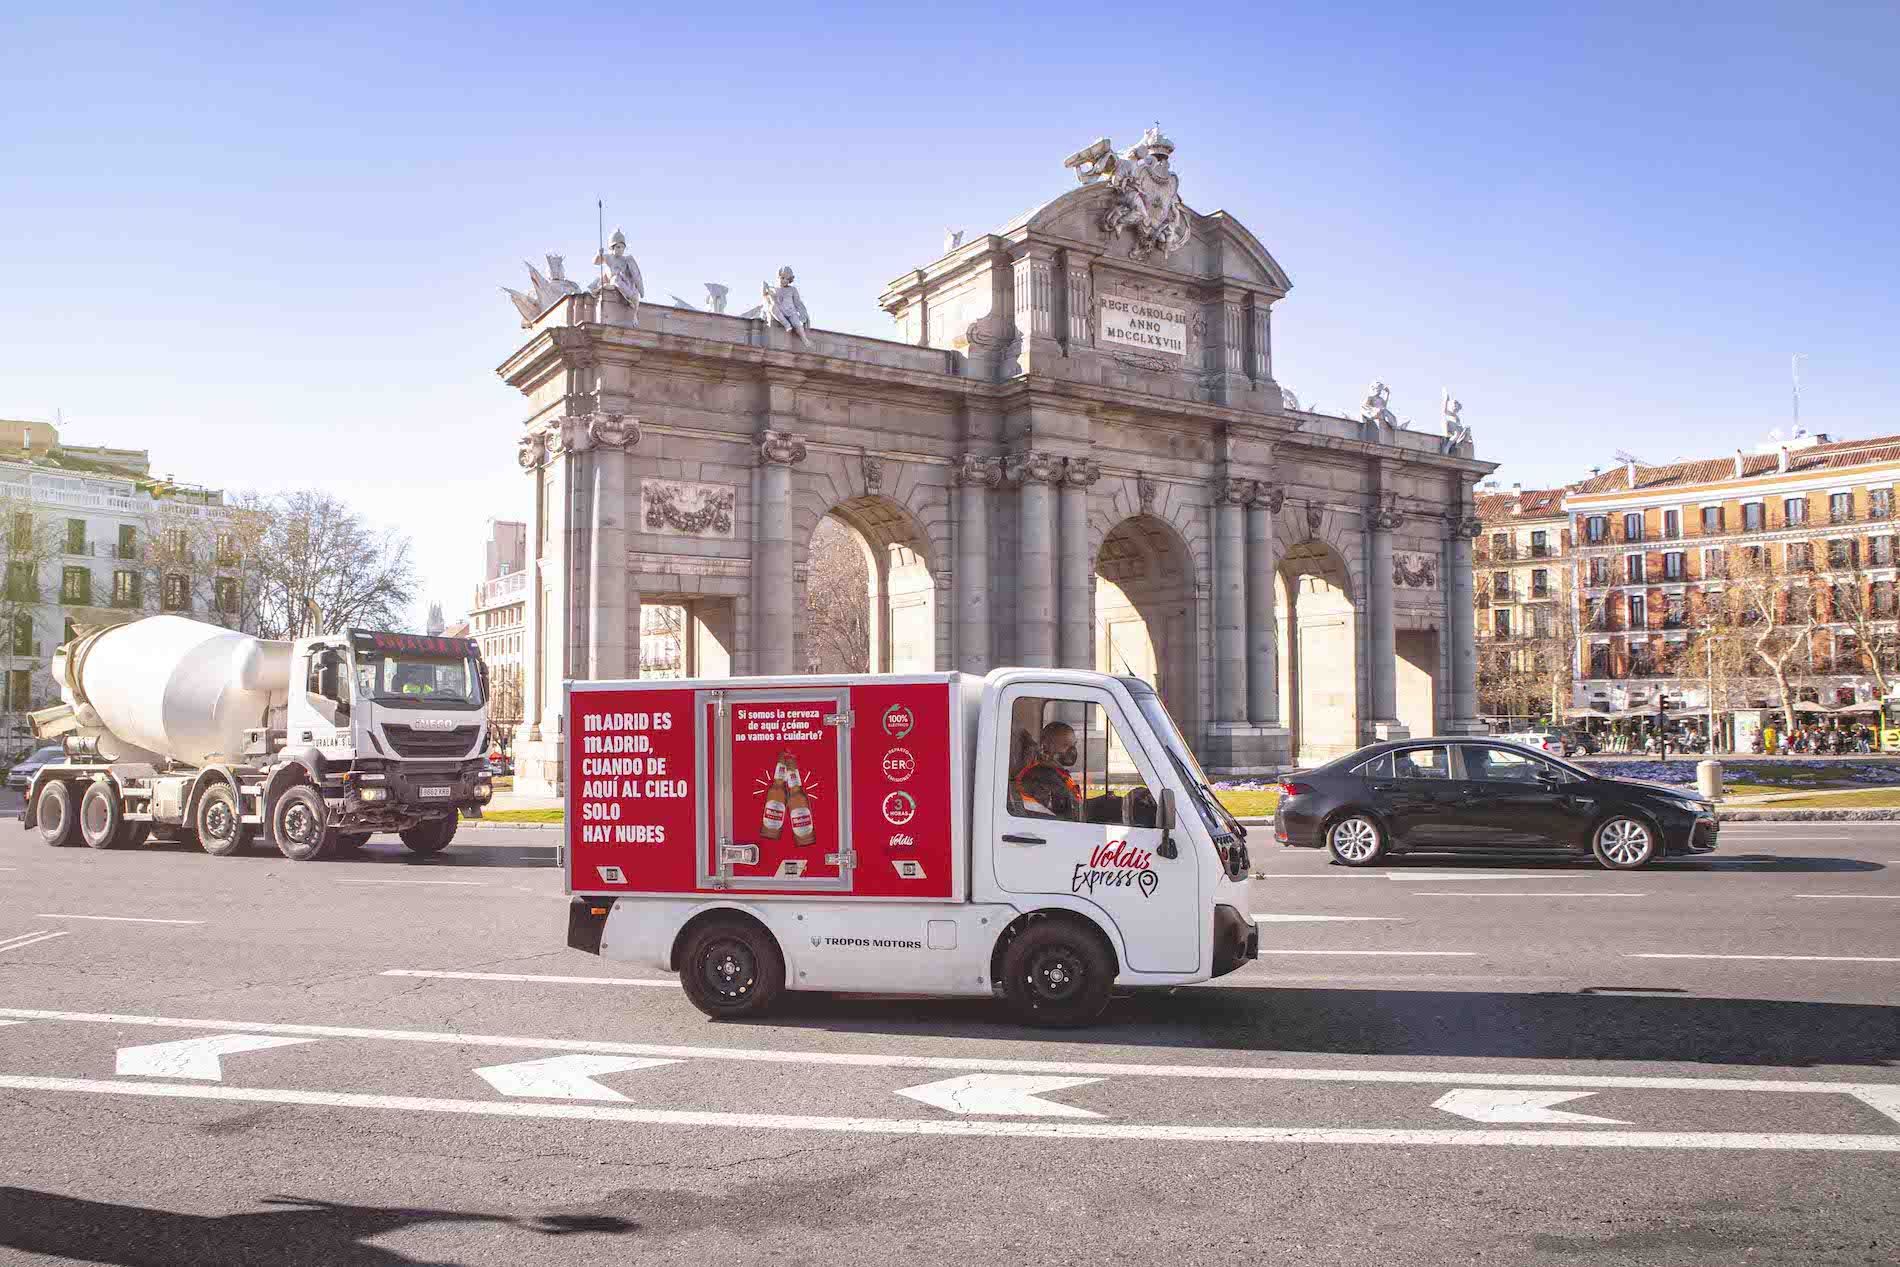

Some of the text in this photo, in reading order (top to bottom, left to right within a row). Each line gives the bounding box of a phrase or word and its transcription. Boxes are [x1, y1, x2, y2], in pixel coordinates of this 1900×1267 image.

[1101, 299, 1187, 325] REGE CAROLO III
[1129, 317, 1161, 333] ANNO
[1107, 326, 1181, 350] MDCCLXXVIII
[583, 712, 672, 731] MADRID ES
[738, 708, 820, 720] Si somos la cerveza
[888, 714, 909, 723] 100%
[748, 719, 809, 732] de aquí ¿cómo
[583, 735, 654, 754] MADRID,
[735, 730, 823, 742] no vamos a cuidarte?
[582, 757, 667, 776] CUANDO DE
[882, 759, 916, 770] CERO
[582, 776, 688, 799] AQUÍ AL CIELO
[582, 802, 621, 820] SOLO
[894, 798, 903, 811] 3
[582, 825, 665, 843] HAY NUBES
[1089, 840, 1152, 870] Voldis
[824, 937, 922, 949] TROPOS MOTORS
